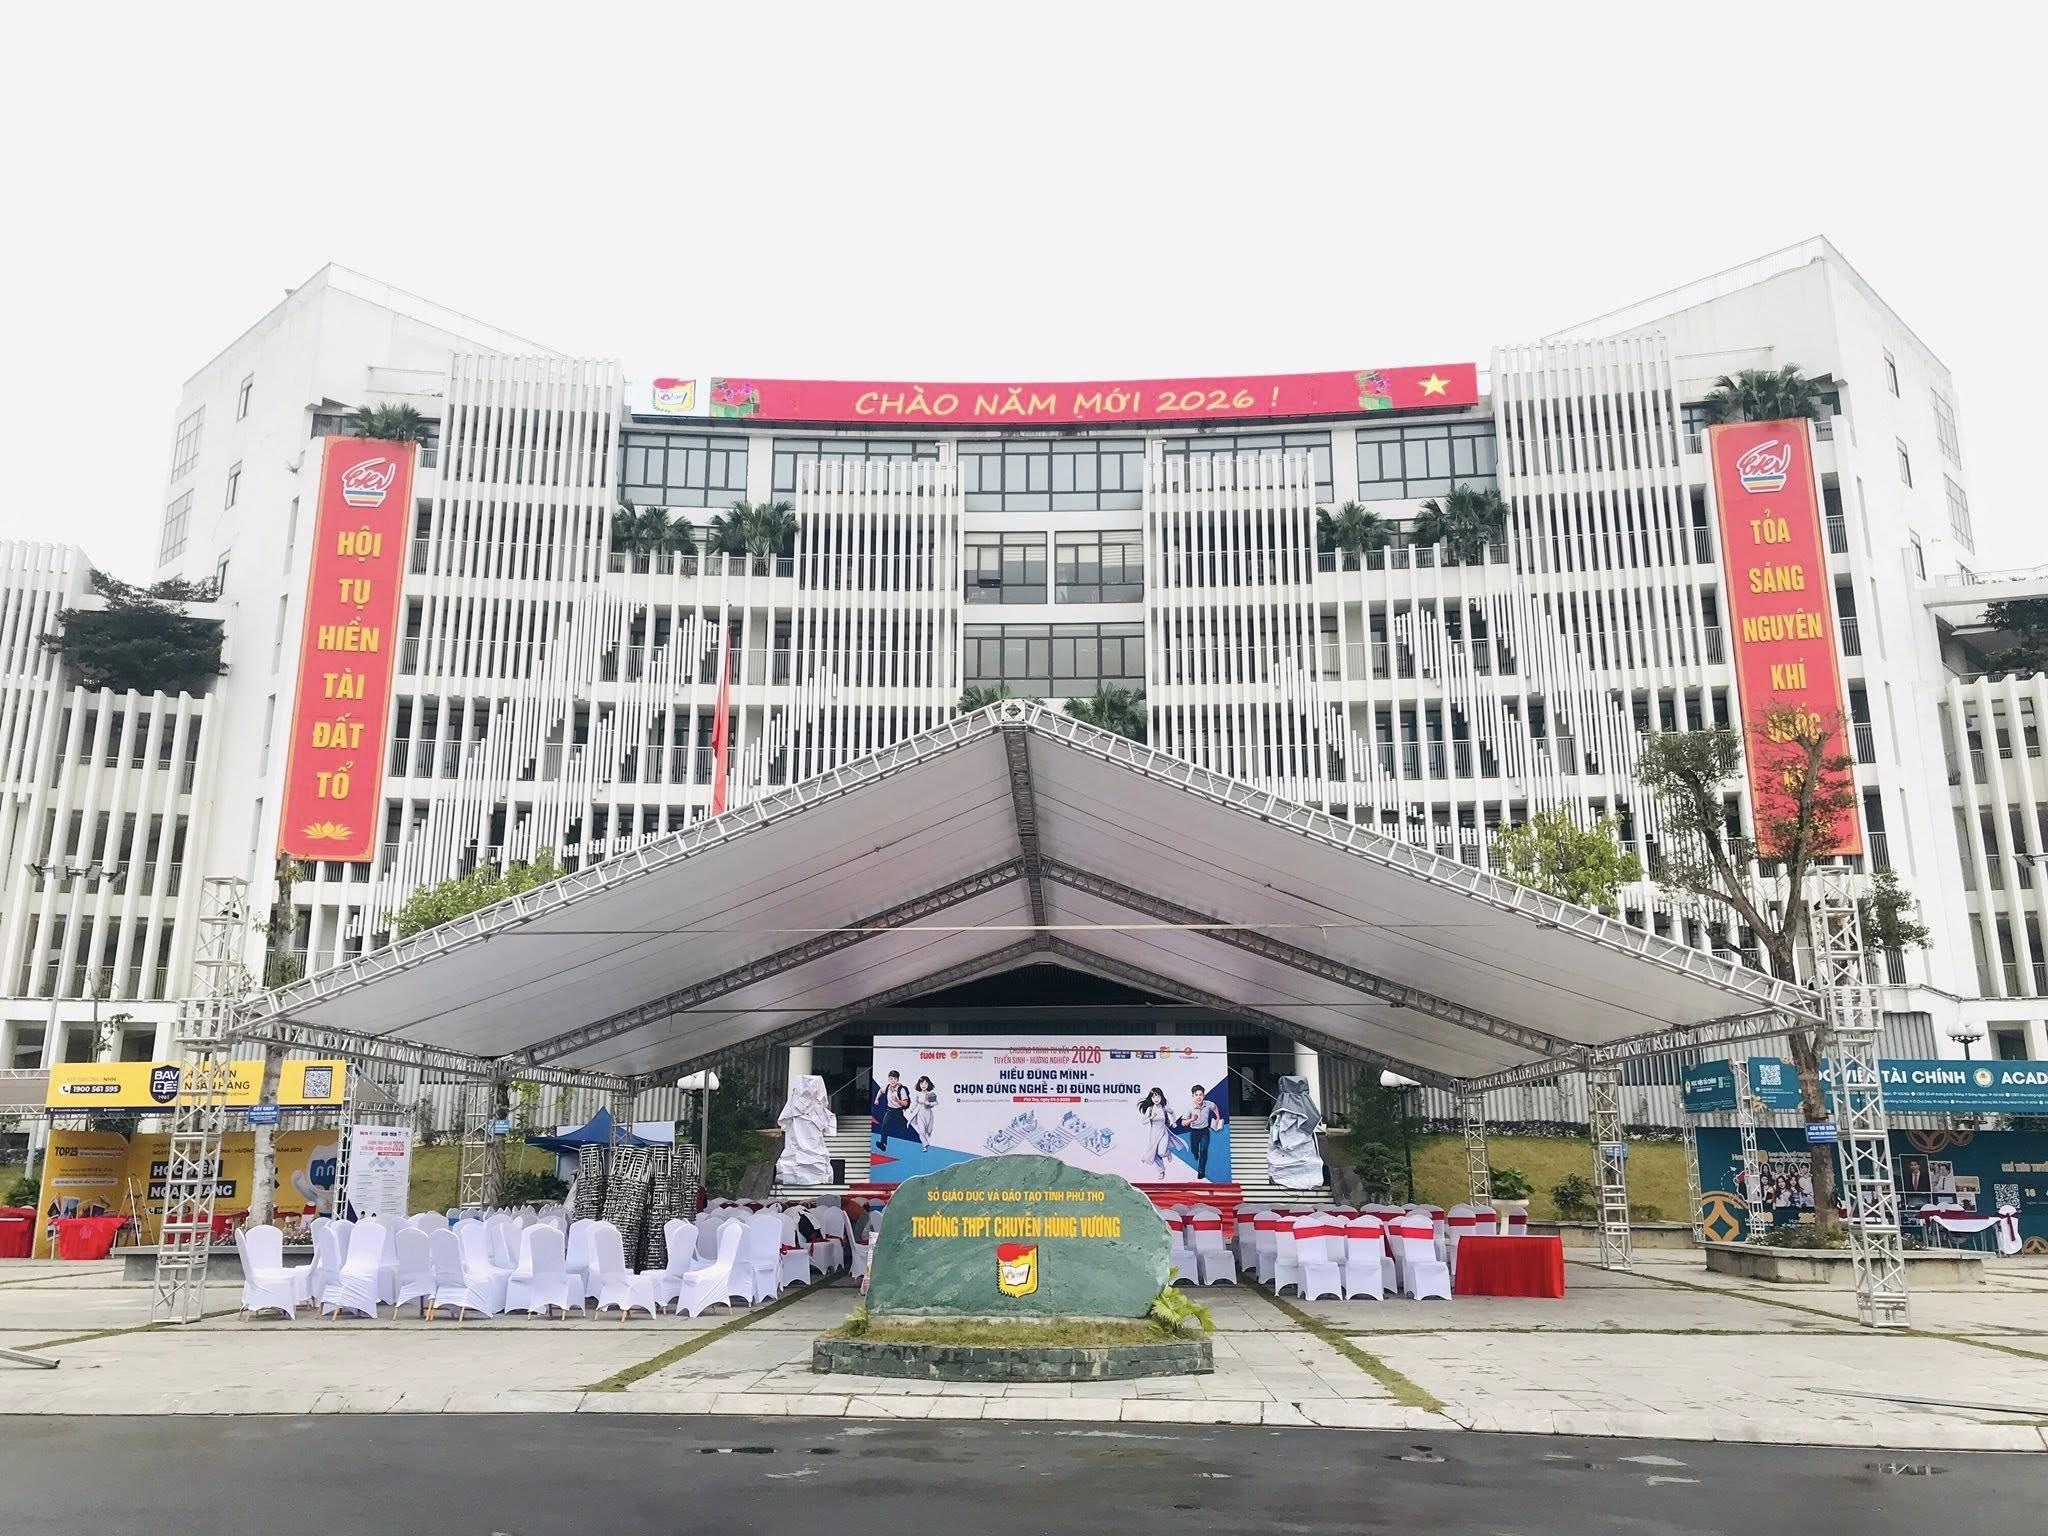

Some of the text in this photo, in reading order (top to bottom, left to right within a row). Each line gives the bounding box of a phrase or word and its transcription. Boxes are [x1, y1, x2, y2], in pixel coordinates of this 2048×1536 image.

[856, 386, 1280, 416] CHÀO NĂM MỚI 2026 !
[1750, 508, 1792, 545] TỎA
[337, 525, 382, 563] HỘI
[1749, 561, 1805, 594] SÁNG
[339, 578, 371, 610] TỤ
[317, 616, 380, 653] HIỀN
[1742, 607, 1823, 643] NGUYÊN
[322, 667, 365, 700] TÀI
[1770, 657, 1807, 691] KHÍ
[311, 713, 364, 750] ĐẤT
[316, 760, 354, 800] TỔ
[1071, 1045, 1102, 1064] 2026
[72, 1085, 90, 1093] 1900
[91, 1085, 103, 1093] 561
[154, 1070, 180, 1080] BAV
[953, 1084, 984, 1096] CHỌN
[986, 1082, 1016, 1094] ĐÚNG
[1019, 1081, 1048, 1094] NGHỀ
[1056, 1084, 1067, 1094] ĐI
[1069, 1082, 1100, 1094] ĐÚNG
[1103, 1081, 1141, 1094] HƯỚNG
[1000, 1066, 1024, 1080] HIỂU
[1027, 1067, 1057, 1080] ĐÚNG
[1059, 1068, 1088, 1080] MÌNH
[1881, 1067, 1907, 1084] TÀI
[1911, 1067, 1966, 1084] CHÍNH
[927, 1187, 940, 1202] SỞ
[941, 1188, 964, 1202] GIÁO
[966, 1191, 985, 1203] DỤC
[987, 1188, 1000, 1202] VÀ
[1023, 1191, 1042, 1204] TẠO
[1044, 1187, 1064, 1202] TỈNH
[1066, 1188, 1085, 1202] PHÚ
[1087, 1191, 1105, 1204] THỌ
[912, 1211, 1121, 1238] TRƯỜNG THPT CHUYÊN HÙNG VƯƠNG
